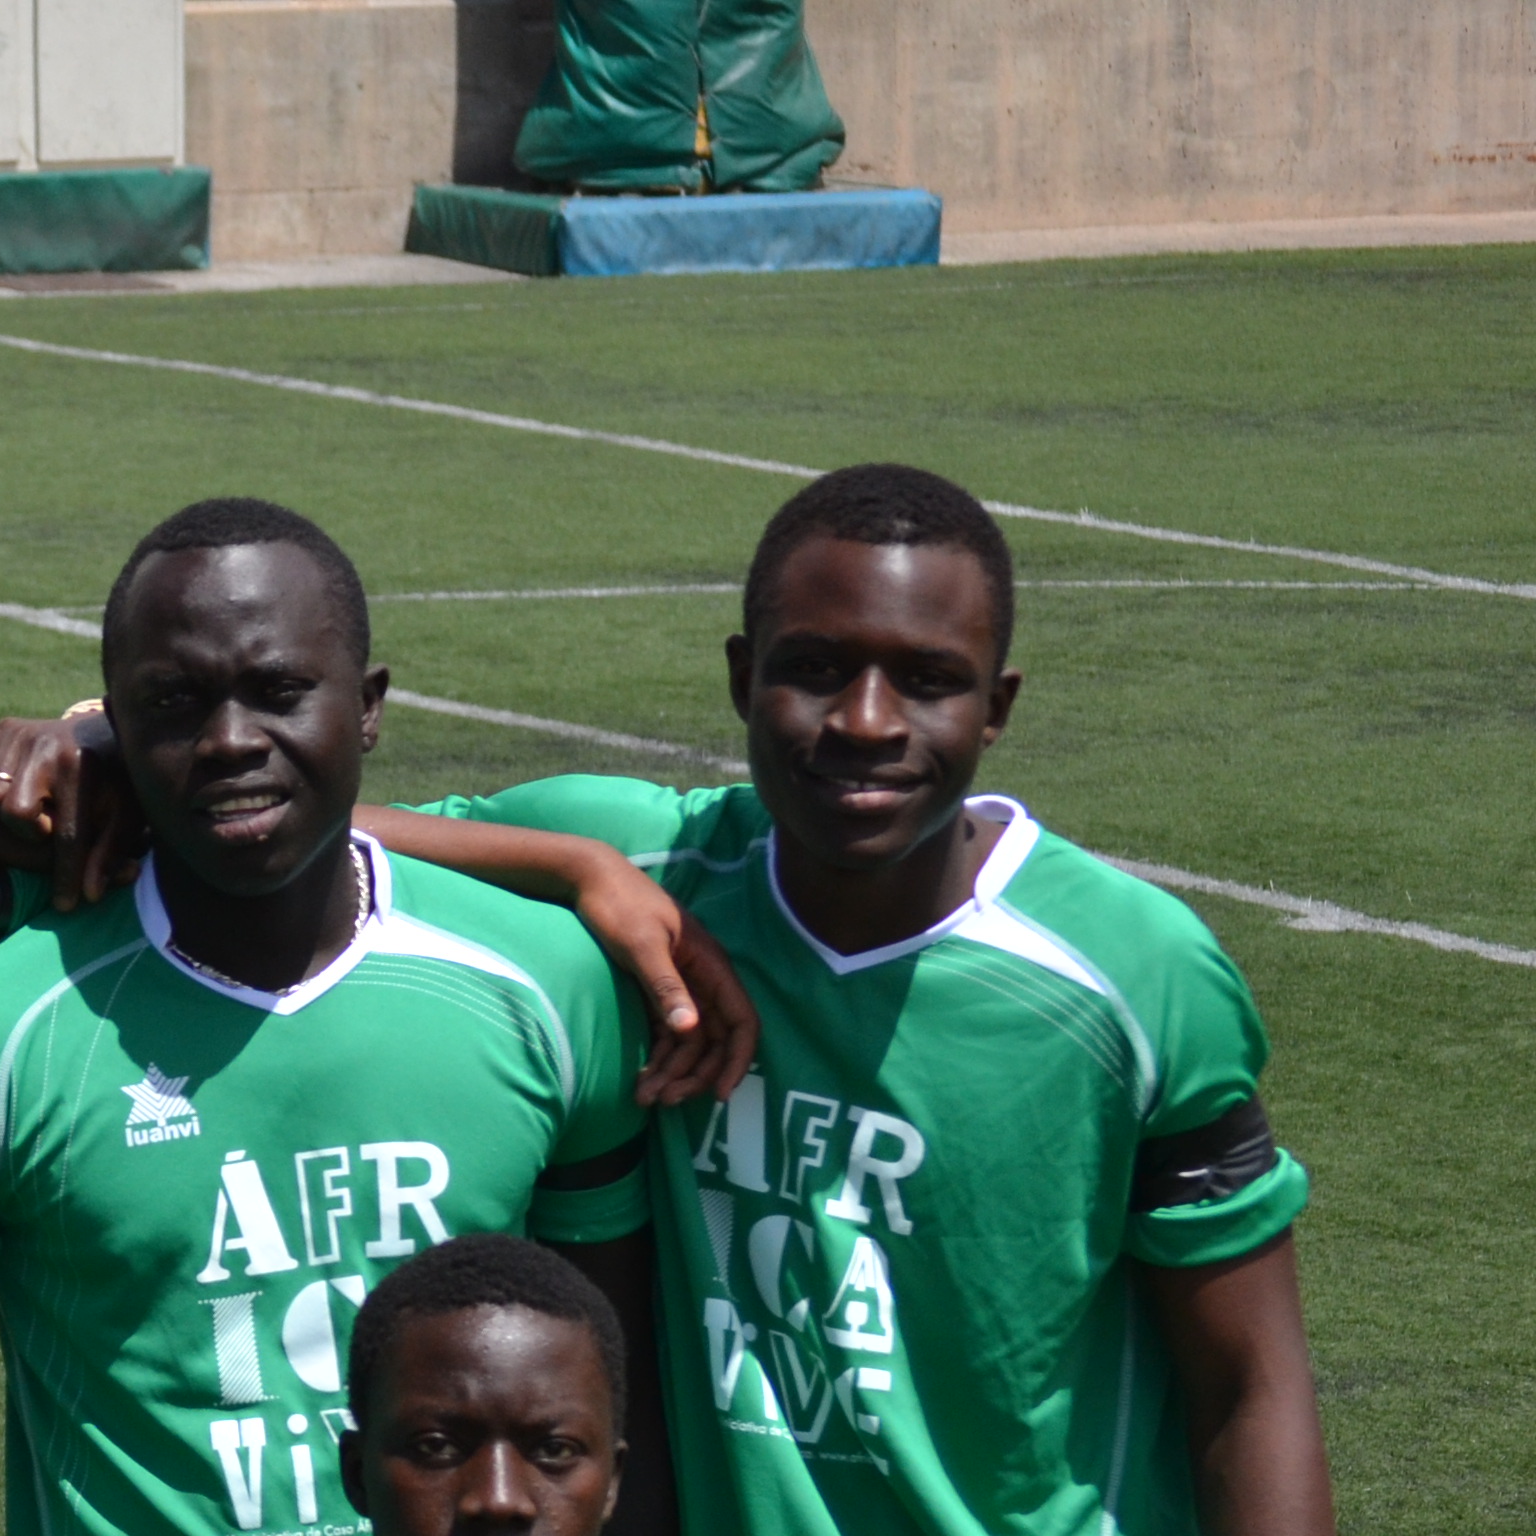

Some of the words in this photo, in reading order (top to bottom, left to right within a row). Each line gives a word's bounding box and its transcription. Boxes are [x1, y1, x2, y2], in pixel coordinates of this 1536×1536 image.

[125, 1117, 200, 1147] luanvi
[196, 1141, 455, 1284] ÁFR
[197, 1274, 368, 1406] IC
